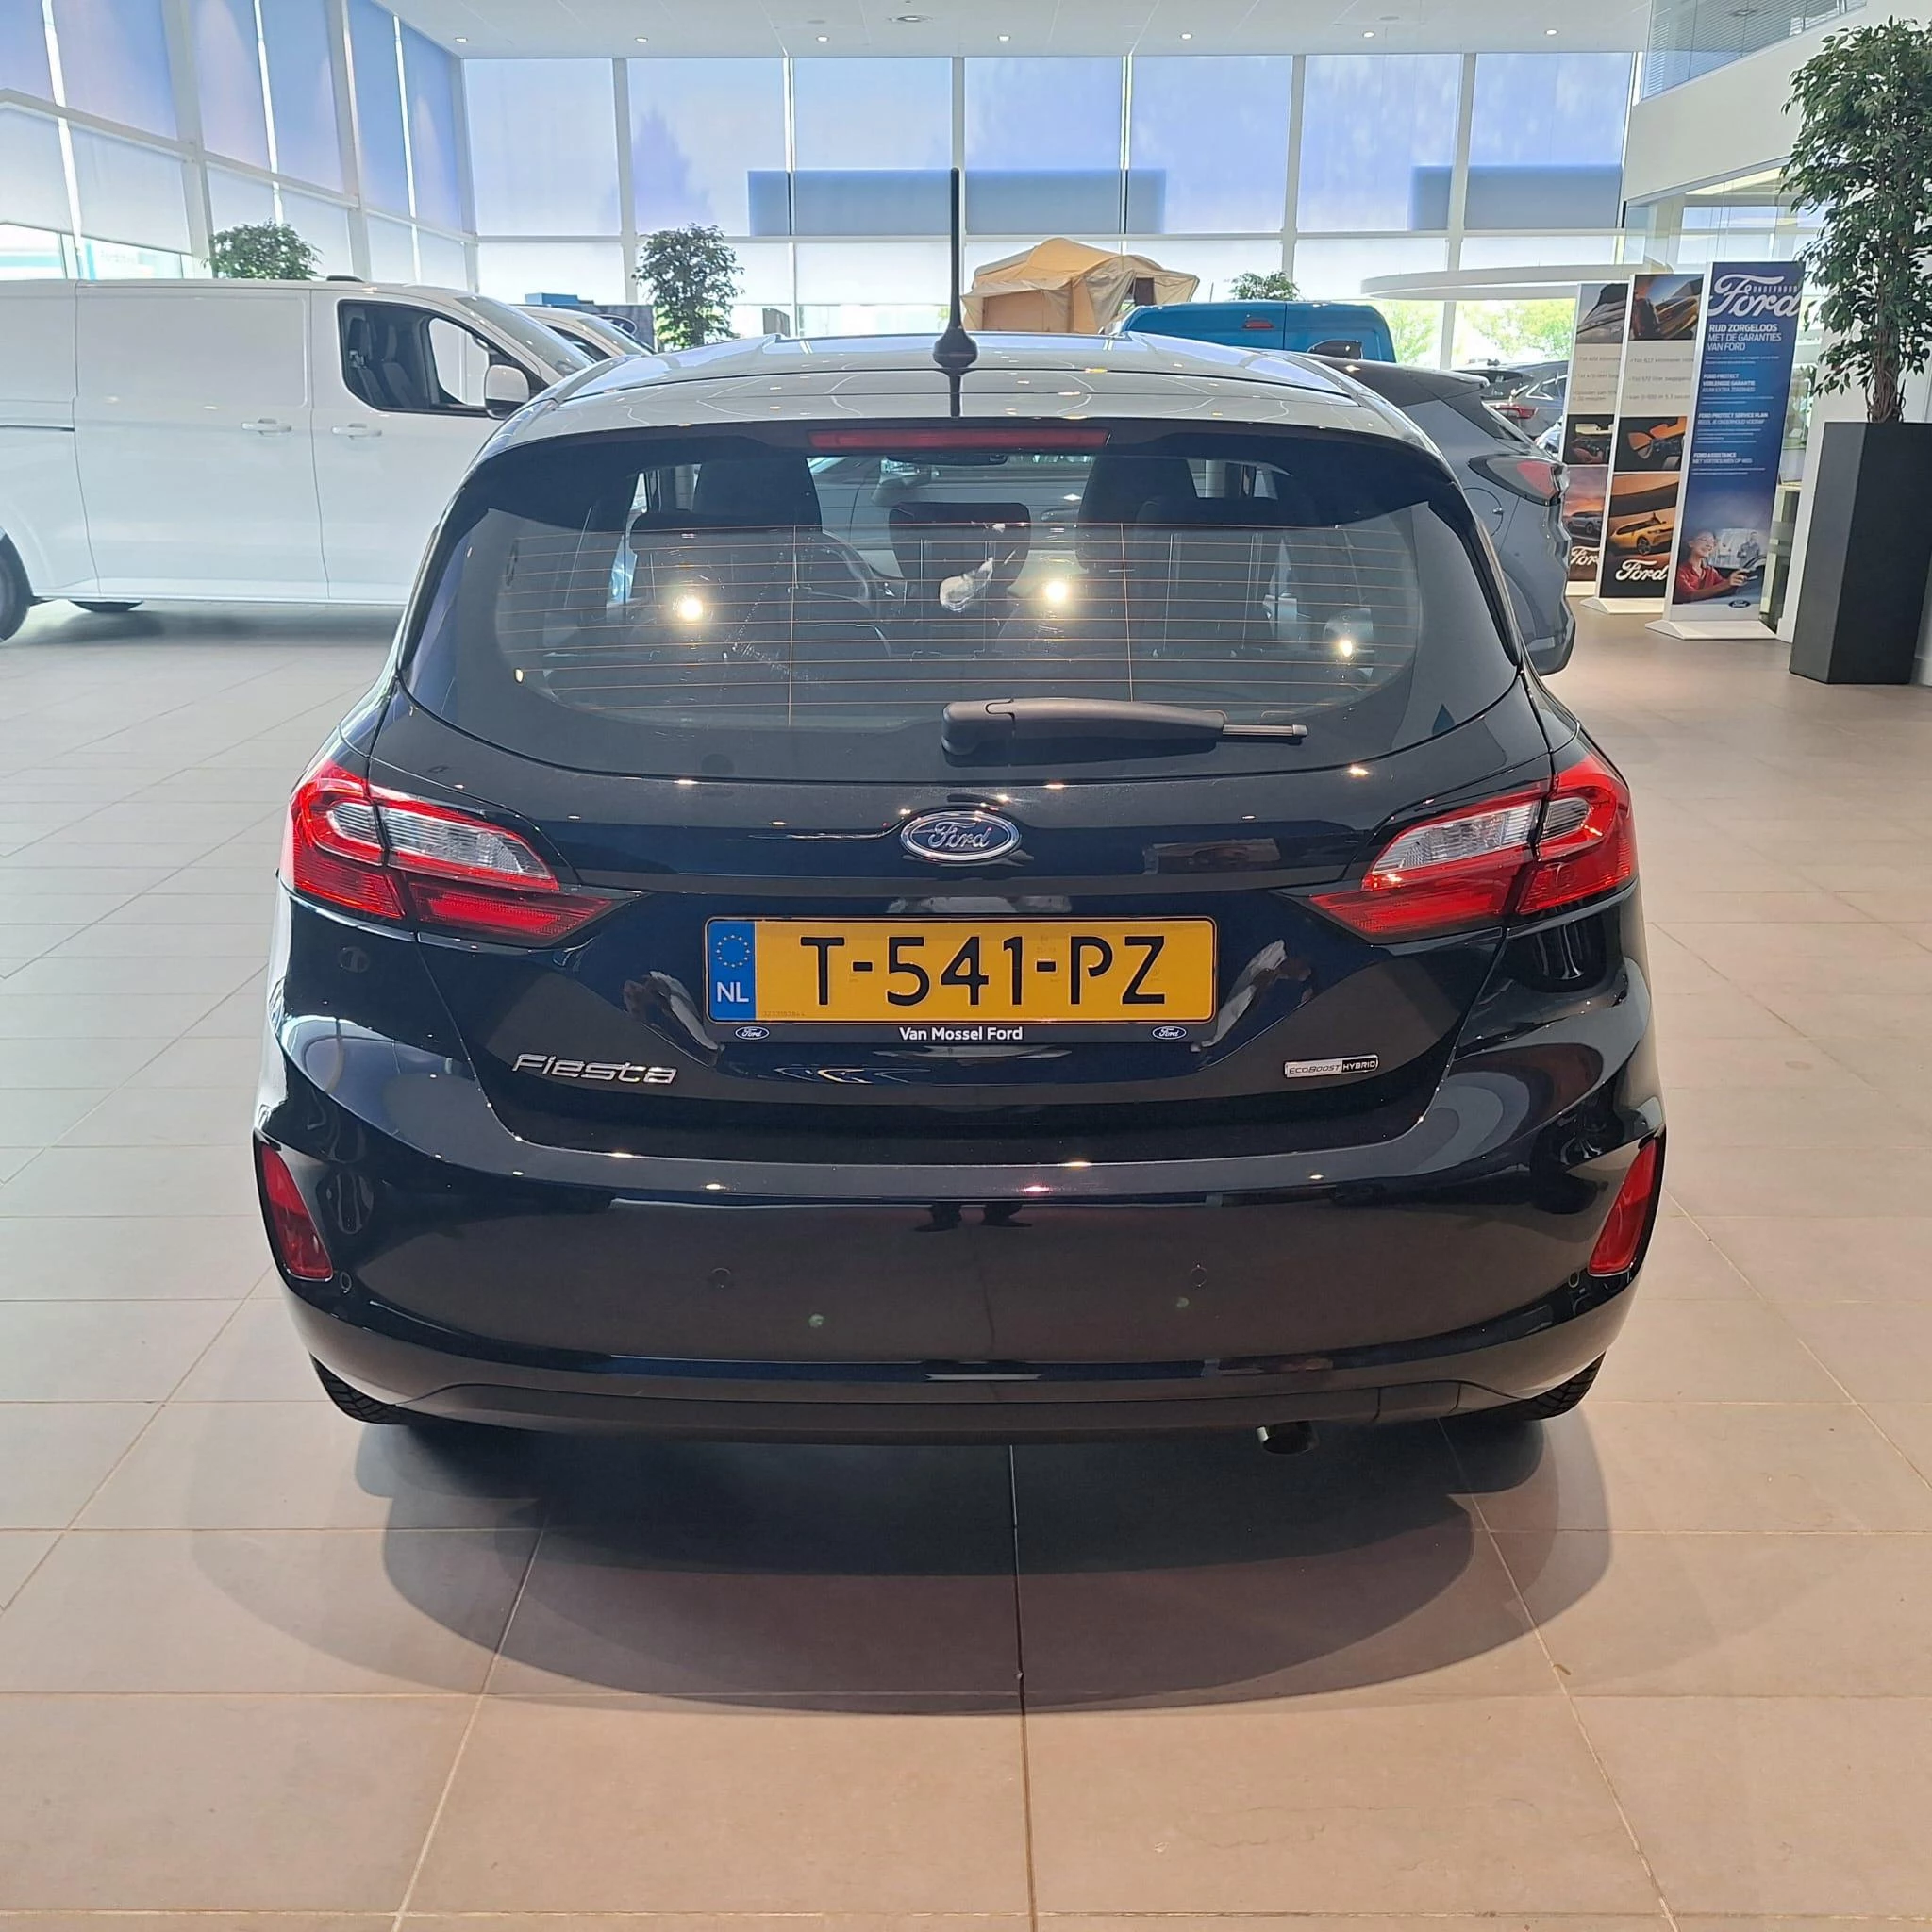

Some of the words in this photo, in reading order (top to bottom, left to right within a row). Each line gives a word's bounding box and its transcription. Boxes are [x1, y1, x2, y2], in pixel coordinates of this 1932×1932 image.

[1707, 274, 1802, 317] Ford
[1708, 333, 1725, 341] MET
[1726, 333, 1737, 341] DE
[1738, 333, 1782, 341] GARANTIES
[1709, 324, 1727, 332] RIJD
[1728, 324, 1777, 332] ZORGELOOS
[1707, 342, 1724, 351] VAN
[1724, 342, 1745, 351] FORD
[1616, 559, 1669, 580] Ford
[912, 821, 992, 848] Ford
[800, 936, 1165, 1006] T-541-PZ
[717, 982, 750, 1003] NL
[899, 1026, 926, 1040] Van
[932, 1026, 983, 1040] Mossel
[987, 1026, 1023, 1040] Ford
[511, 1053, 677, 1084] Fiesta
[1342, 1060, 1376, 1071] HYBRID
